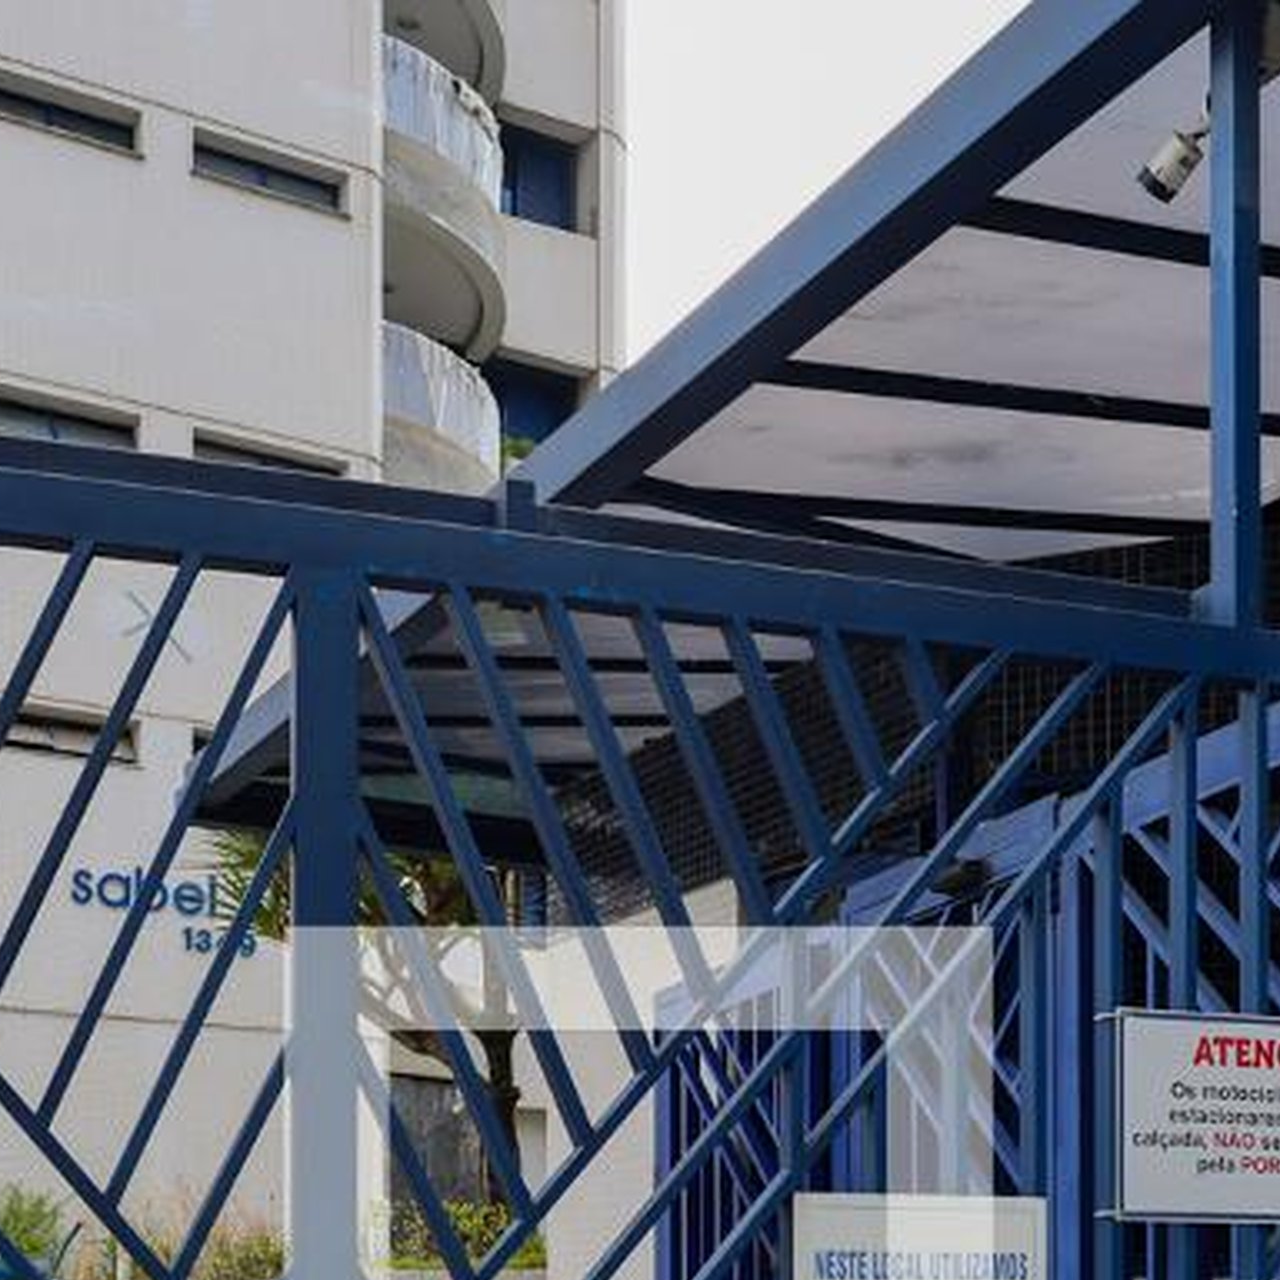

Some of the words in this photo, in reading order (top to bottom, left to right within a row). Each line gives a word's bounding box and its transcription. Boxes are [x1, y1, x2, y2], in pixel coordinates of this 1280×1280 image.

[1170, 1081, 1195, 1100] Os
[1132, 1130, 1207, 1153] calçada,
[1213, 1130, 1257, 1148] NÃO
[1196, 1156, 1237, 1176] pela
[813, 1251, 868, 1280] NESTE
[872, 1251, 924, 1280] LOCAL
[929, 1252, 1029, 1280] UTILIZAMOS
